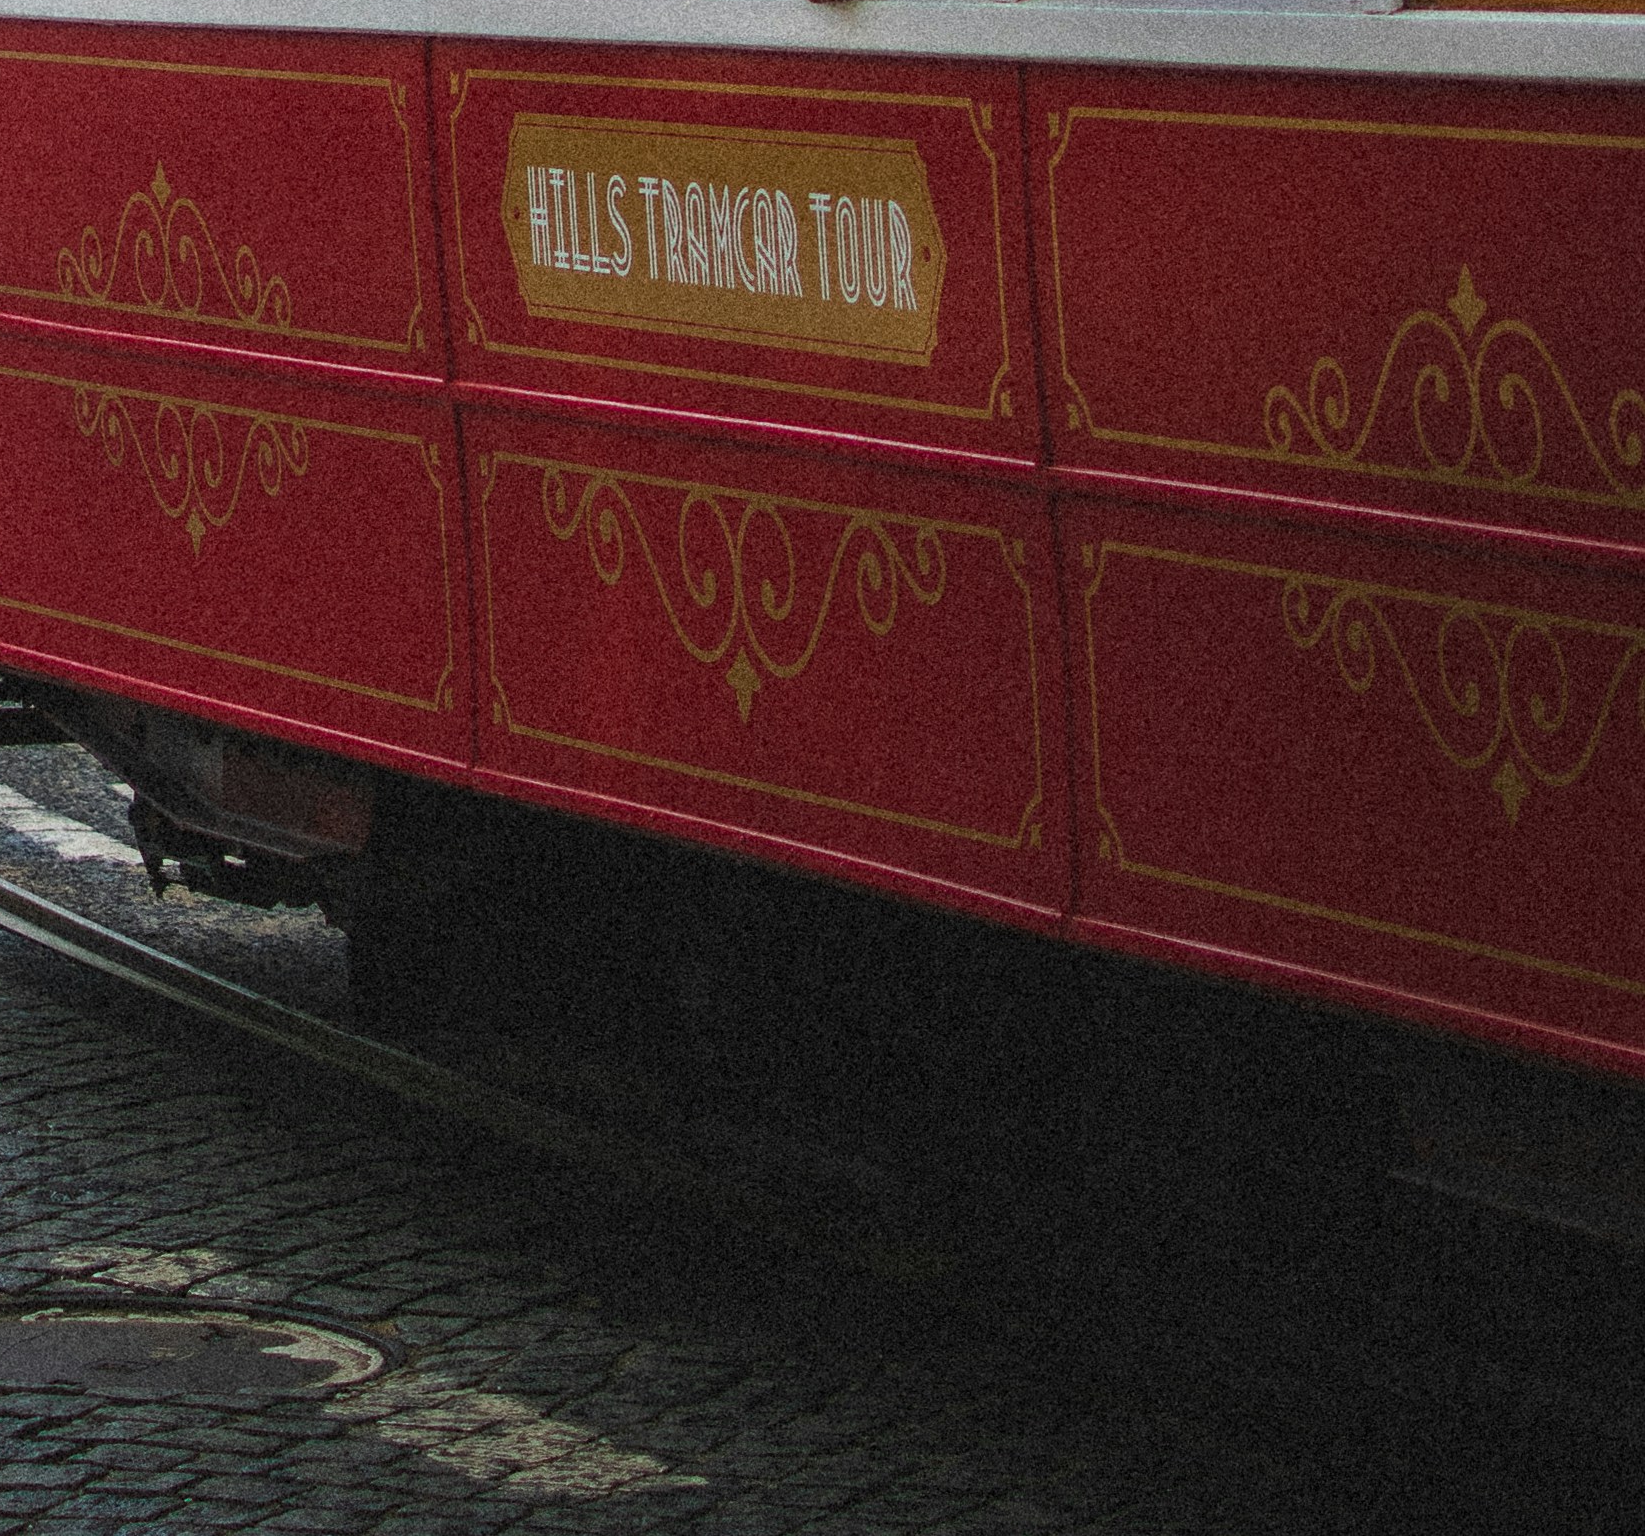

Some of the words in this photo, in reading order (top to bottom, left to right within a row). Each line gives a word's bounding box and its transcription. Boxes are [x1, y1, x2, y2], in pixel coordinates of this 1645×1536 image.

[526, 165, 632, 277] HILLS
[638, 177, 804, 298] TRAMCAR
[808, 191, 918, 312] TOUR
